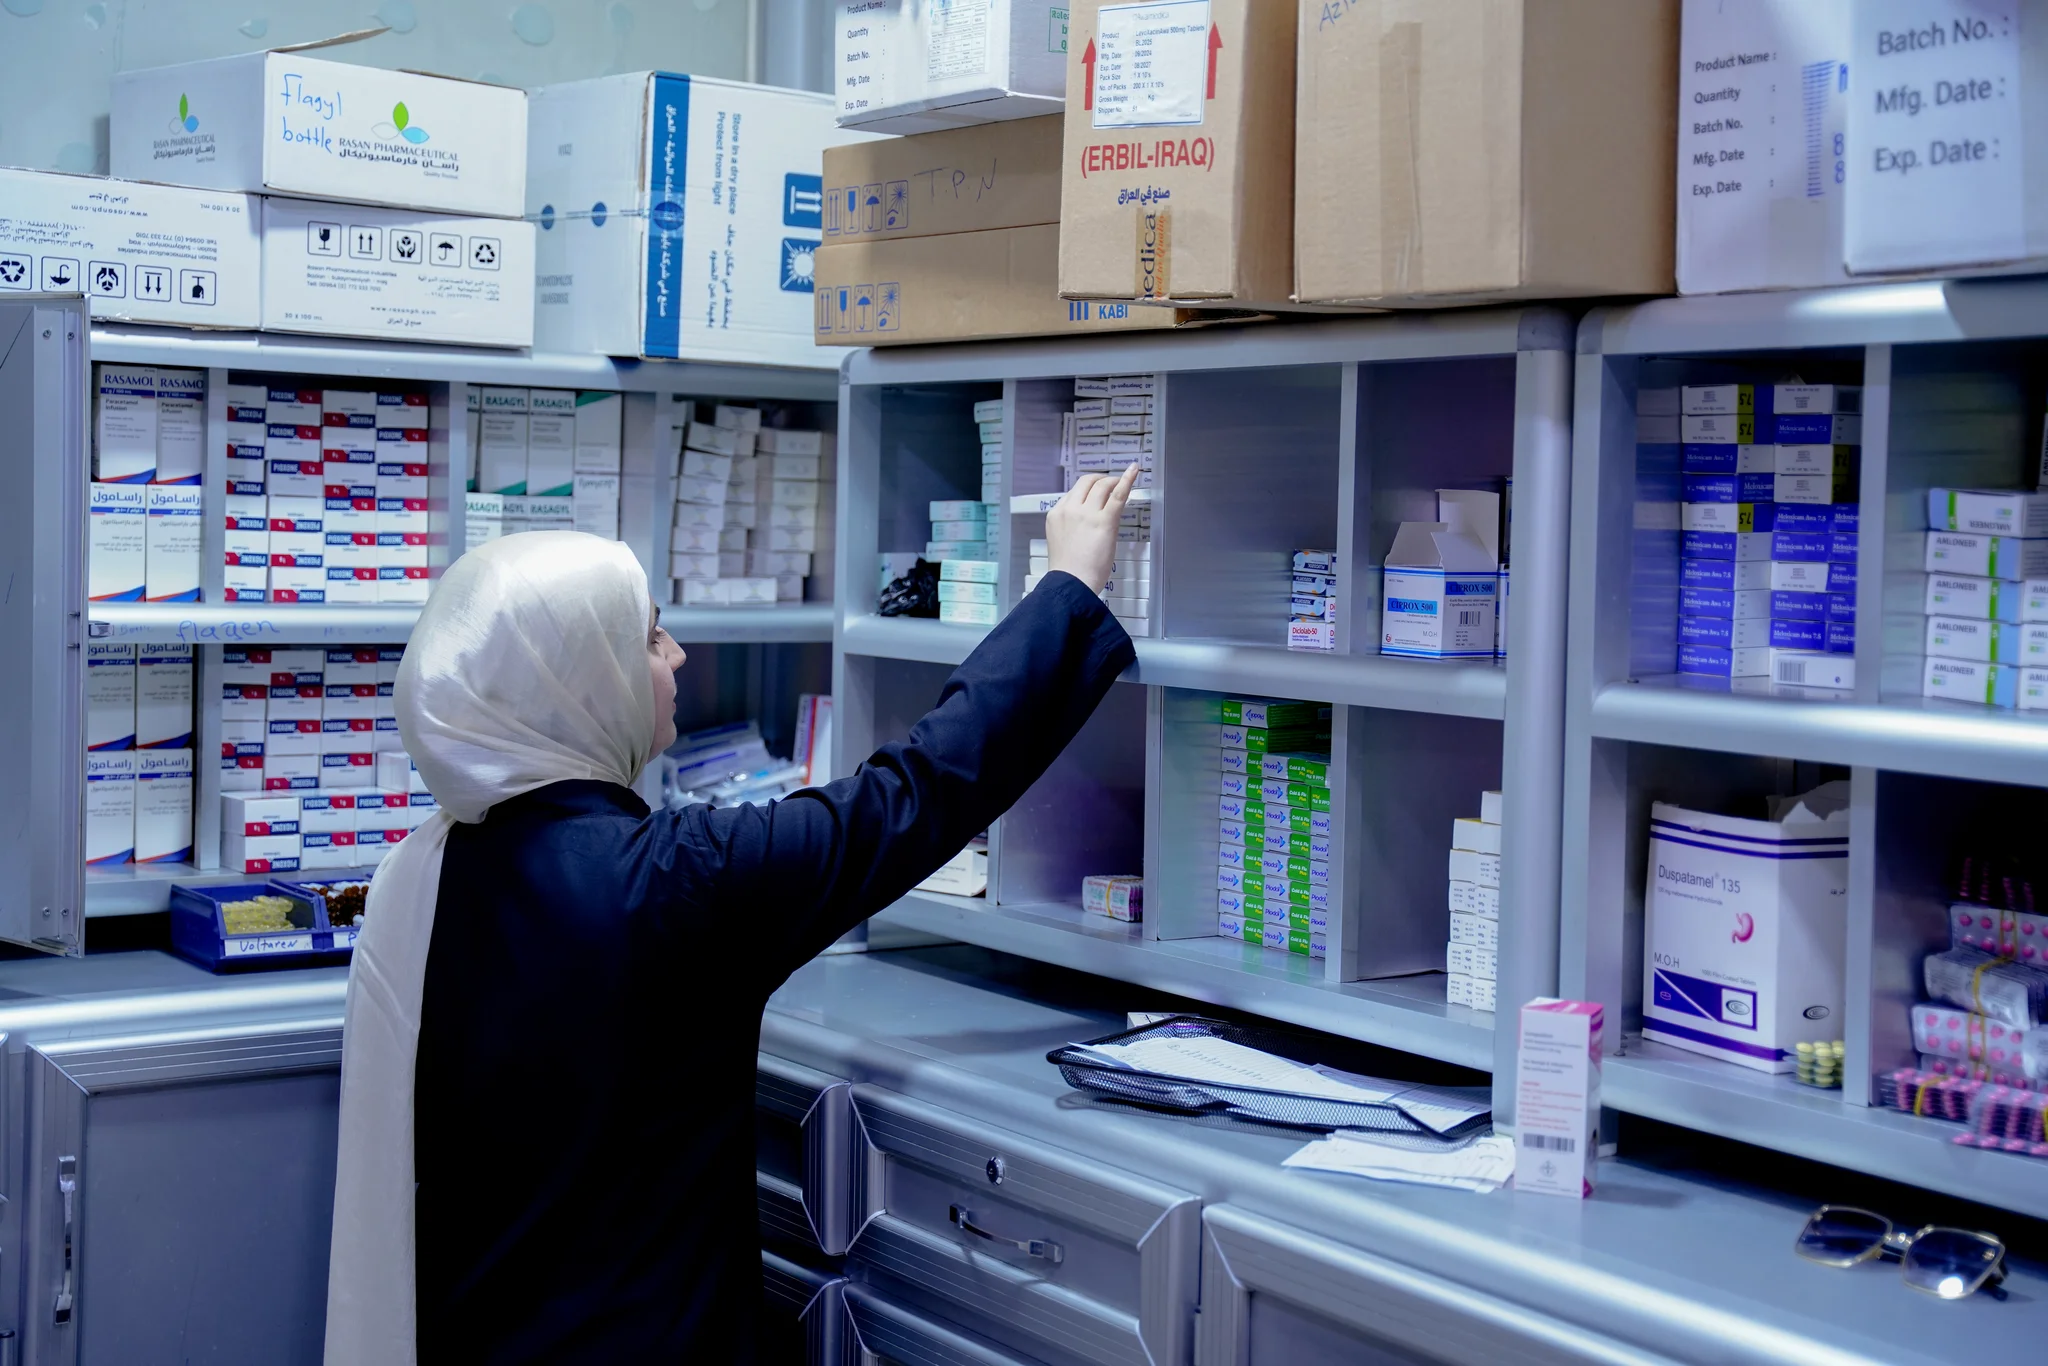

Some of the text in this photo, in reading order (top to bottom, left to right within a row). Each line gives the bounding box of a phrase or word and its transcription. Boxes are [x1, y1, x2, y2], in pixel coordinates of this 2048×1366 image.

[847, 0, 883, 15] Product Name
[847, 26, 869, 39] Quantity
[1101, 24, 1205, 40] Product 500mg Tablets
[1878, 16, 1994, 56] Batch No.
[847, 50, 870, 63] Batch No.
[1694, 52, 1770, 73] Product Name
[1110, 63, 1121, 71] Date
[846, 75, 870, 87] Mfg. Date
[1111, 73, 1121, 81] Size
[1112, 83, 1127, 91] Packs
[1132, 82, 1142, 90] 200
[1098, 94, 1155, 104] Gross Weight Kg
[1694, 87, 1741, 105] Quantity
[1874, 77, 1993, 118] Mfg. Date
[845, 98, 868, 111] Exp. Date
[1098, 106, 1115, 115] Shipper
[1693, 117, 1743, 134] Batch No.
[169, 134, 216, 148] PHARMACEUTICAL
[283, 115, 332, 154] bottle
[339, 137, 459, 162] RASAN PHARMACEUTICAL
[711, 111, 726, 206] Protect from light
[727, 112, 742, 215] Store dry place
[1081, 136, 1215, 179] (ERBIL-IRAQ)
[1693, 148, 1745, 168] Mfg. Date
[1873, 138, 1987, 177] Exp. Date
[1117, 185, 1171, 206] صنع في العراق
[1692, 180, 1742, 198] Exp. Date
[117, 246, 148, 254] Industries
[1099, 303, 1128, 320] KABI
[104, 373, 155, 387] RASAMOL
[160, 377, 205, 390] RASAMO
[485, 396, 525, 407] RASAGYL
[533, 398, 573, 410] RASAGYL
[530, 503, 570, 515] RASAGYL
[1685, 540, 1711, 549] Meloxicam
[1449, 583, 1493, 593] CIPROX 500
[1391, 600, 1434, 612] CIPROX 500
[1683, 597, 1710, 607] Meloxicam
[1682, 626, 1708, 636] Meloxicam
[1658, 863, 1741, 894] Duspatamel 135
[1653, 951, 1680, 969] M.O.H
